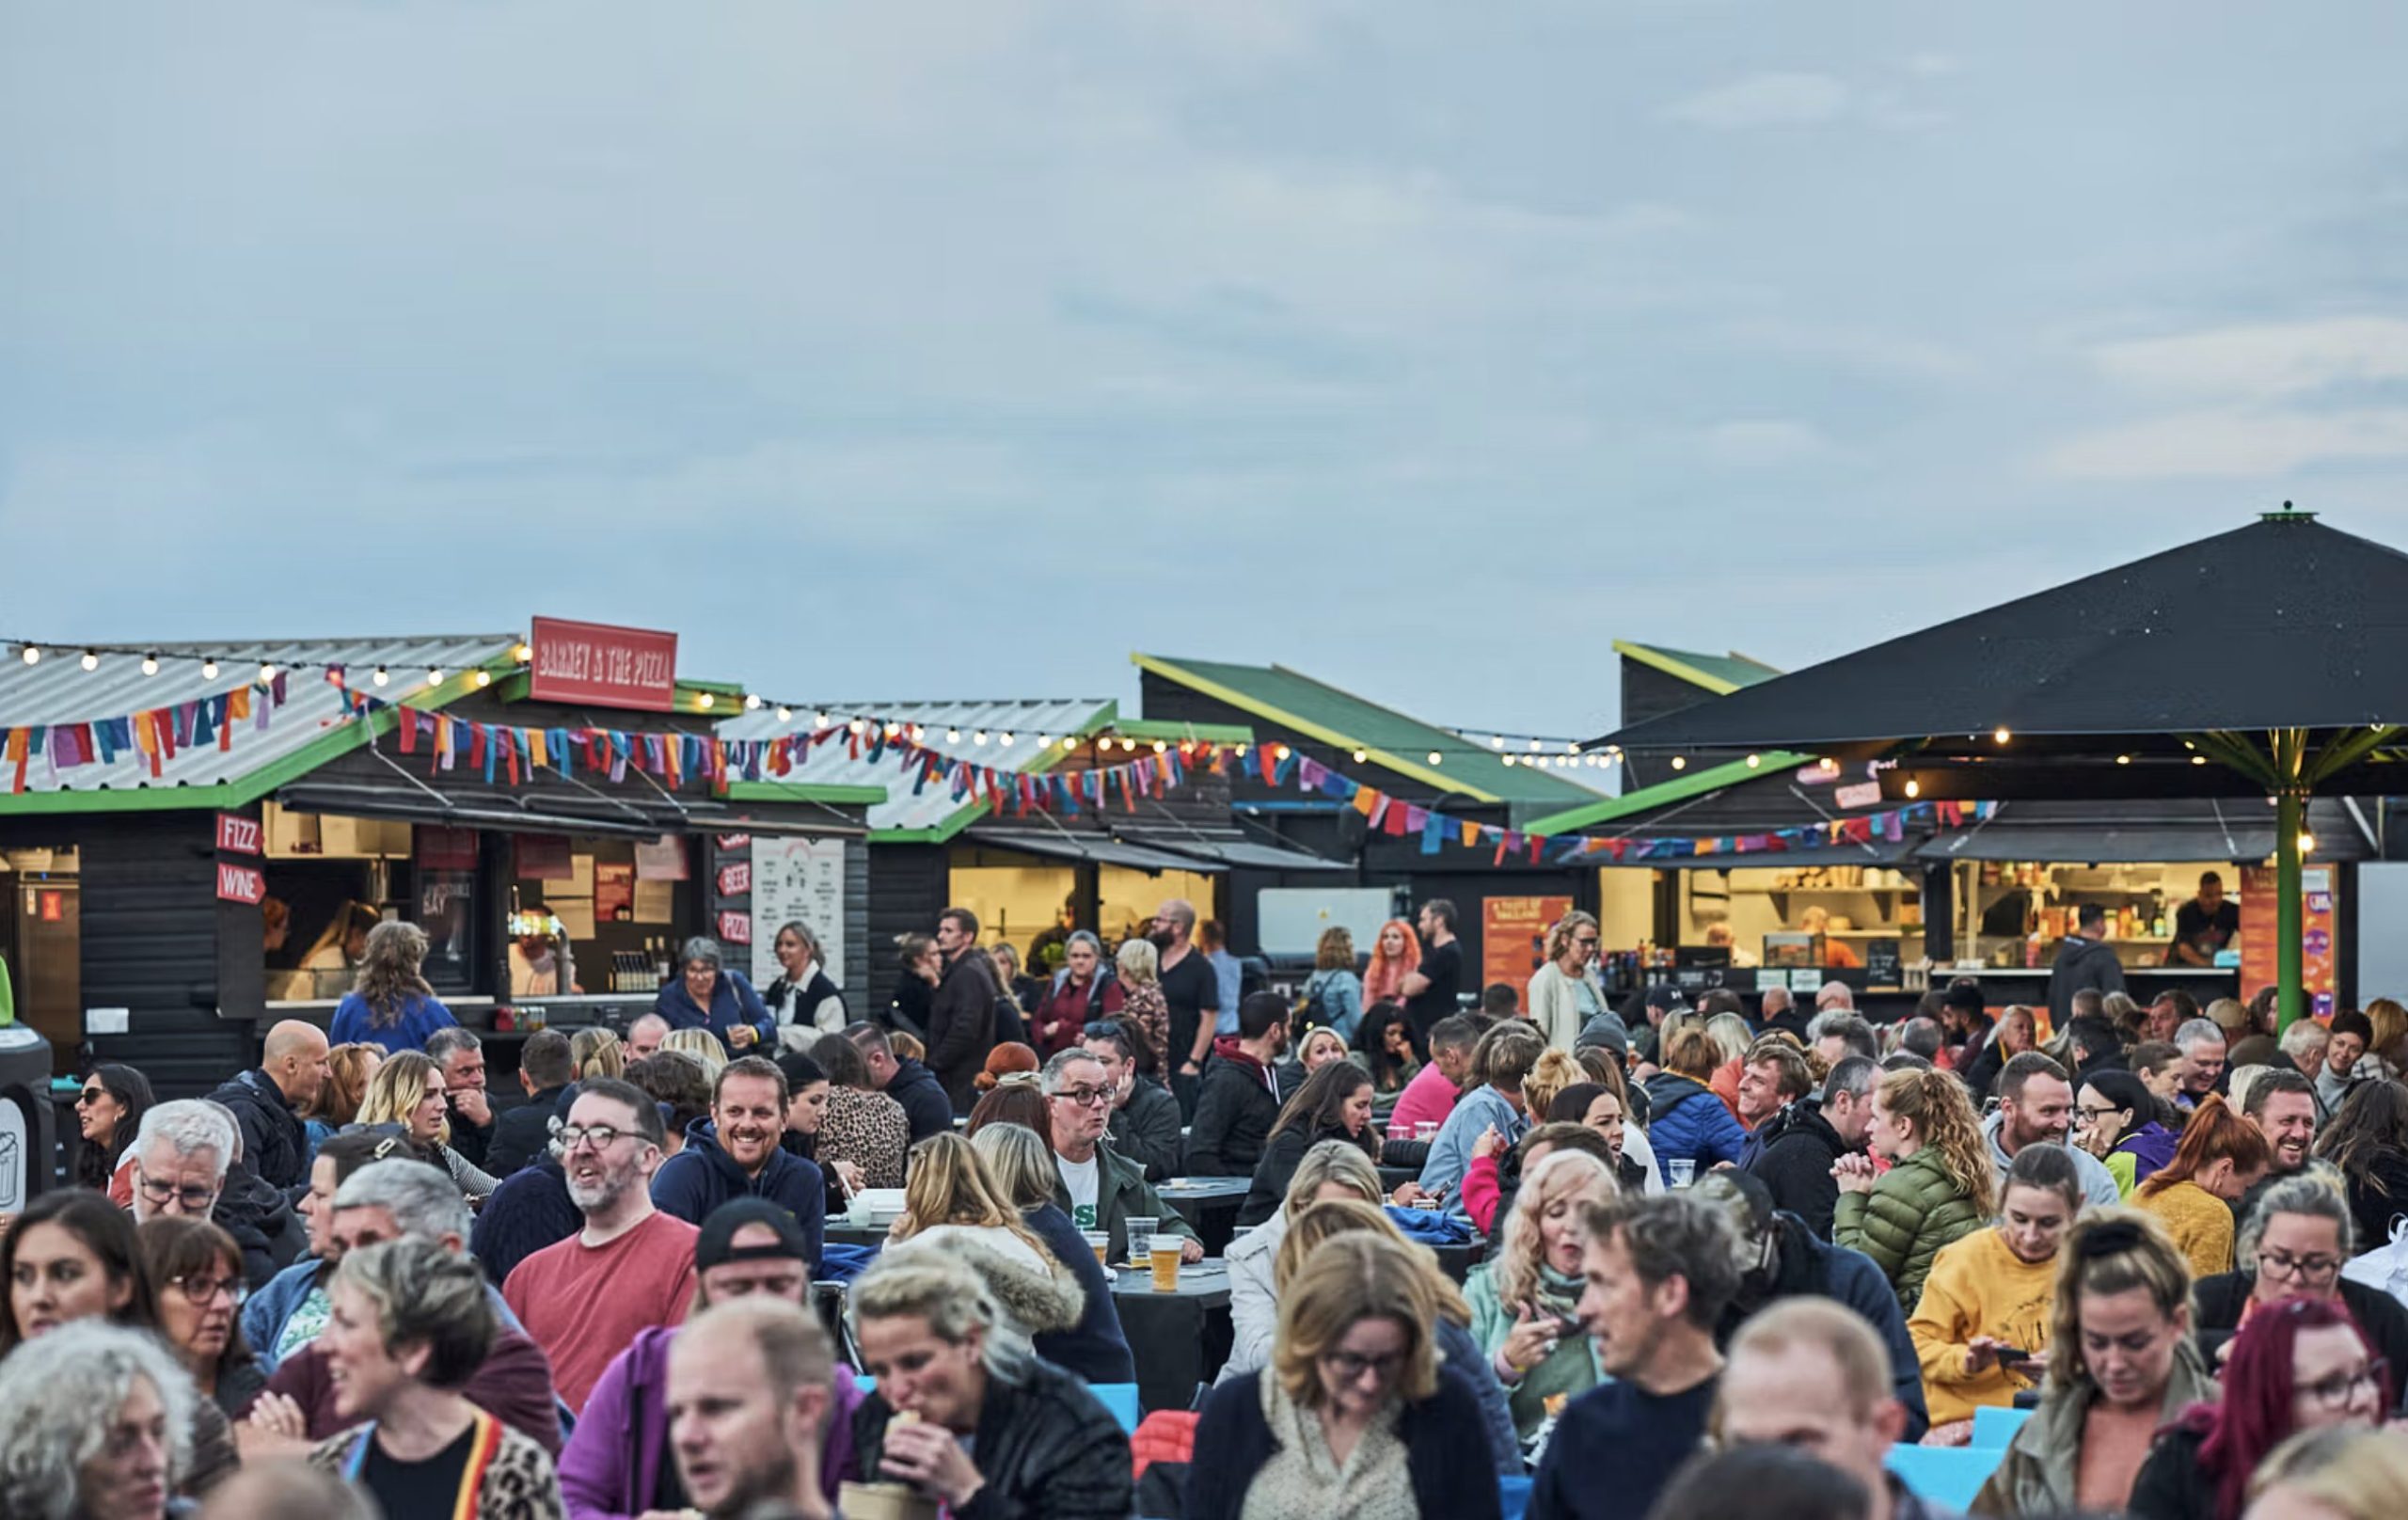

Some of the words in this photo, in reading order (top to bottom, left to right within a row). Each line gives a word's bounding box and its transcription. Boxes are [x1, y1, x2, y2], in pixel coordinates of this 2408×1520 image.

[607, 646, 631, 685] THE
[633, 650, 669, 688] PIZZA
[224, 817, 257, 850] FIZZ
[222, 866, 257, 899] WINE
[724, 863, 750, 893] BEER
